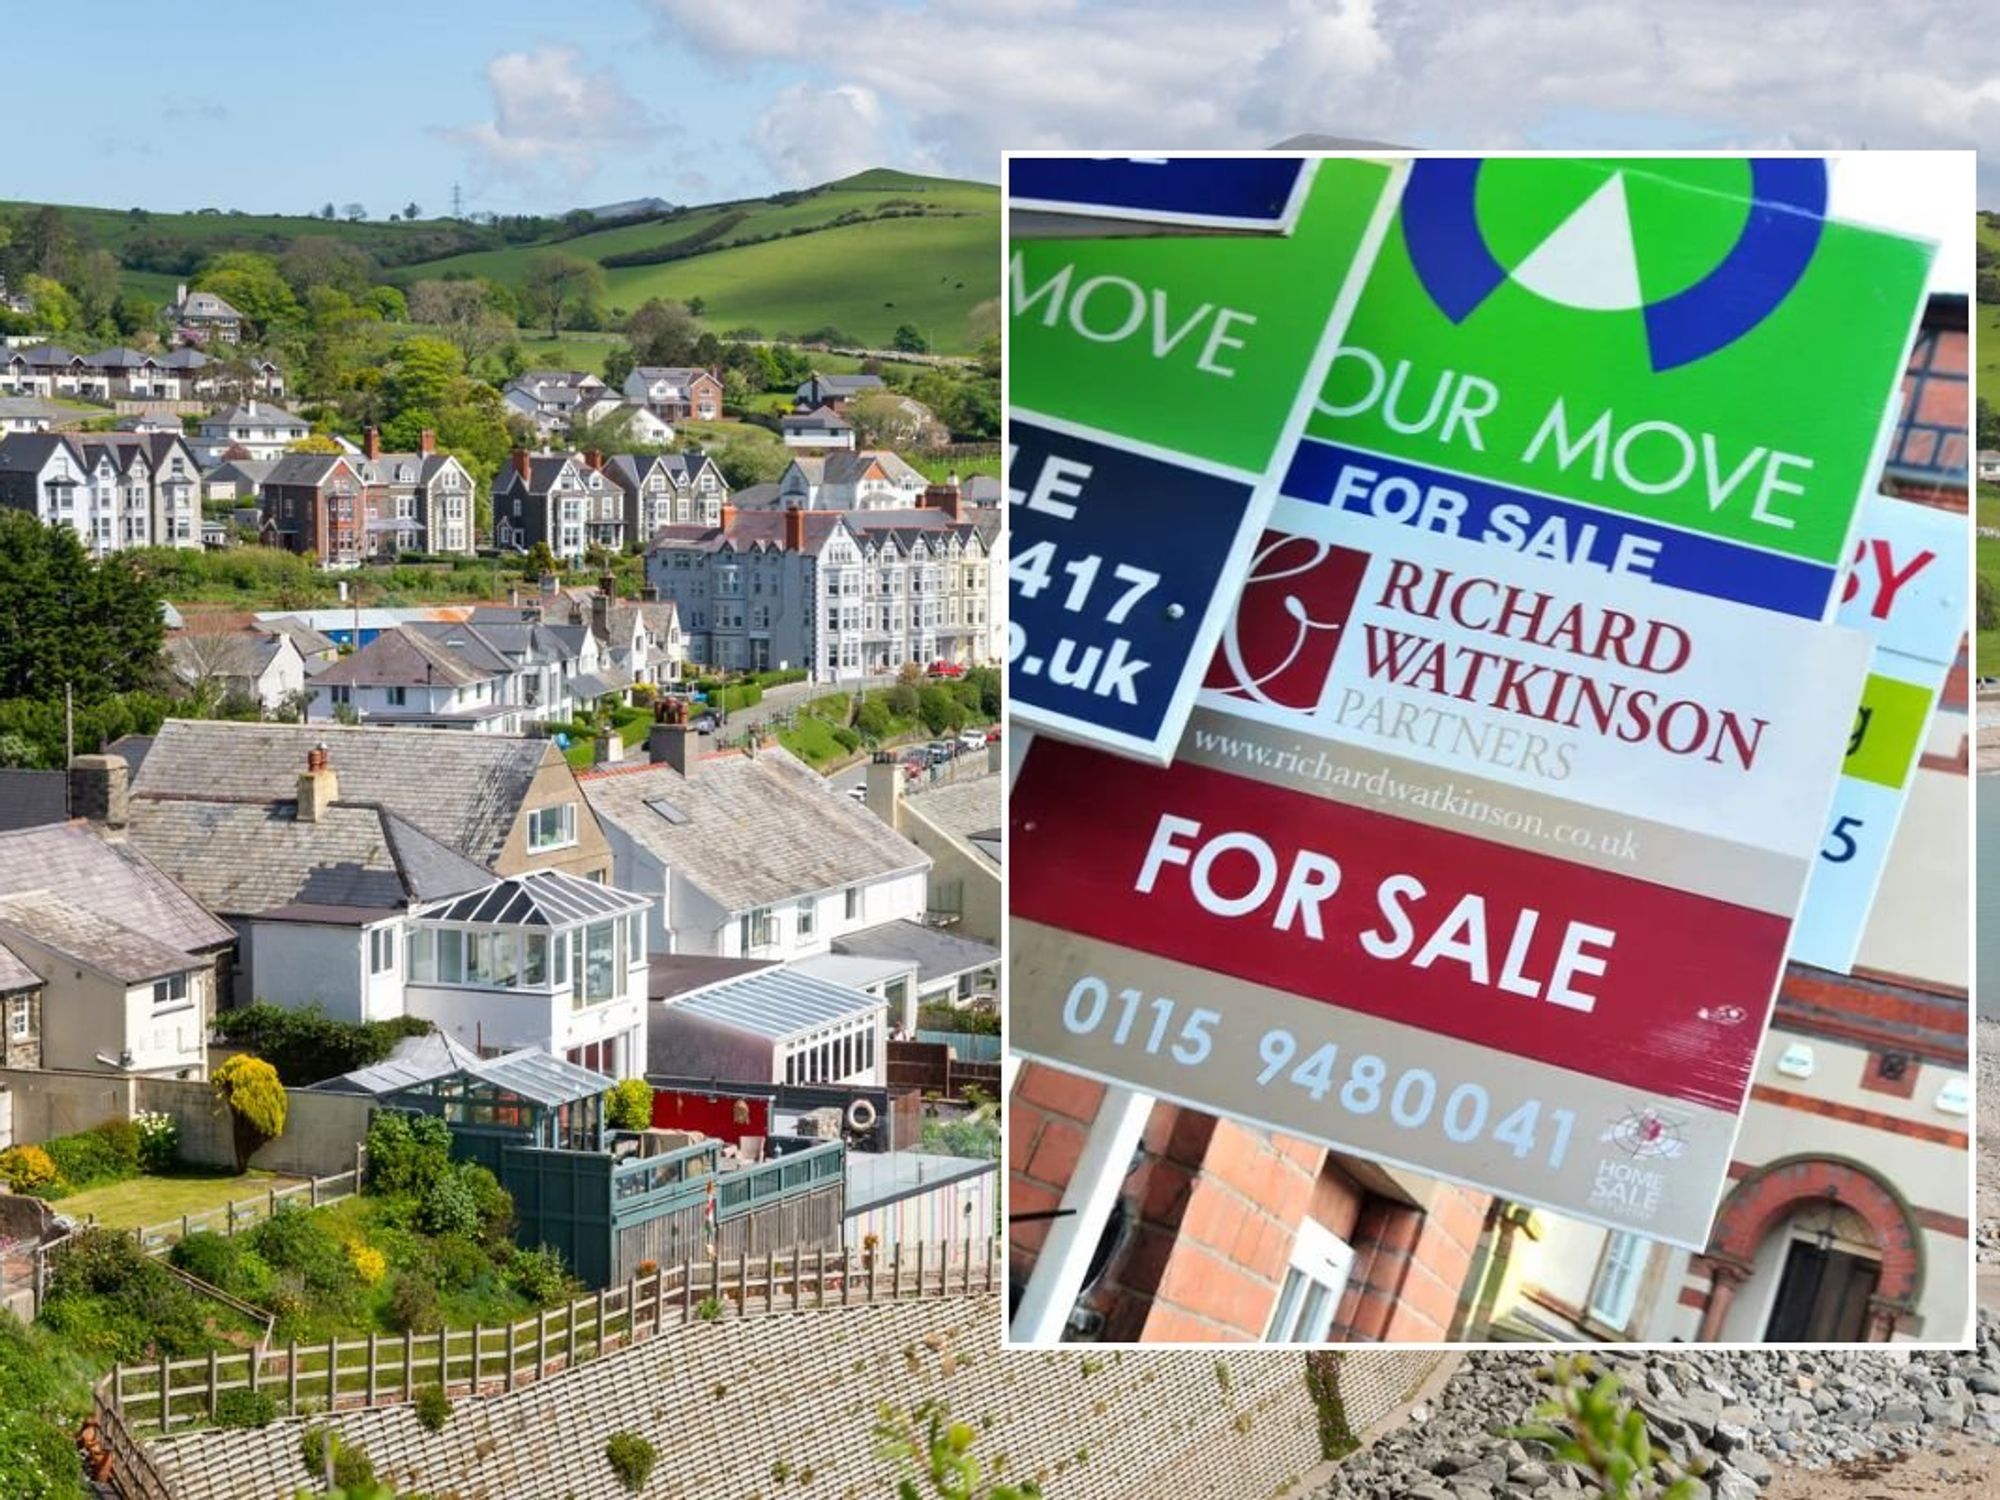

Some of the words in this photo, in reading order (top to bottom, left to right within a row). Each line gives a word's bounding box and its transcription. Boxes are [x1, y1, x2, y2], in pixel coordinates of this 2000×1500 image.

[1009, 250, 1257, 378] MOVE
[1314, 346, 1499, 451] OUR
[1520, 396, 1814, 529] MOVE
[1329, 464, 1469, 539] FOR
[1482, 504, 1663, 582] SALE
[1376, 558, 1691, 676] RICHARD
[1331, 686, 1578, 781] PARTNERS
[1363, 623, 1770, 772] WATKINSON
[1194, 728, 1640, 863] www.richardwatkinson.co.uk
[1134, 813, 1342, 941] FOR
[1360, 873, 1616, 1013] SALE
[1062, 976, 1221, 1066] 0115
[1256, 1028, 1577, 1169] 9480041
[1591, 1177, 1660, 1211] SALE
[1599, 1158, 1664, 1189] HOME
